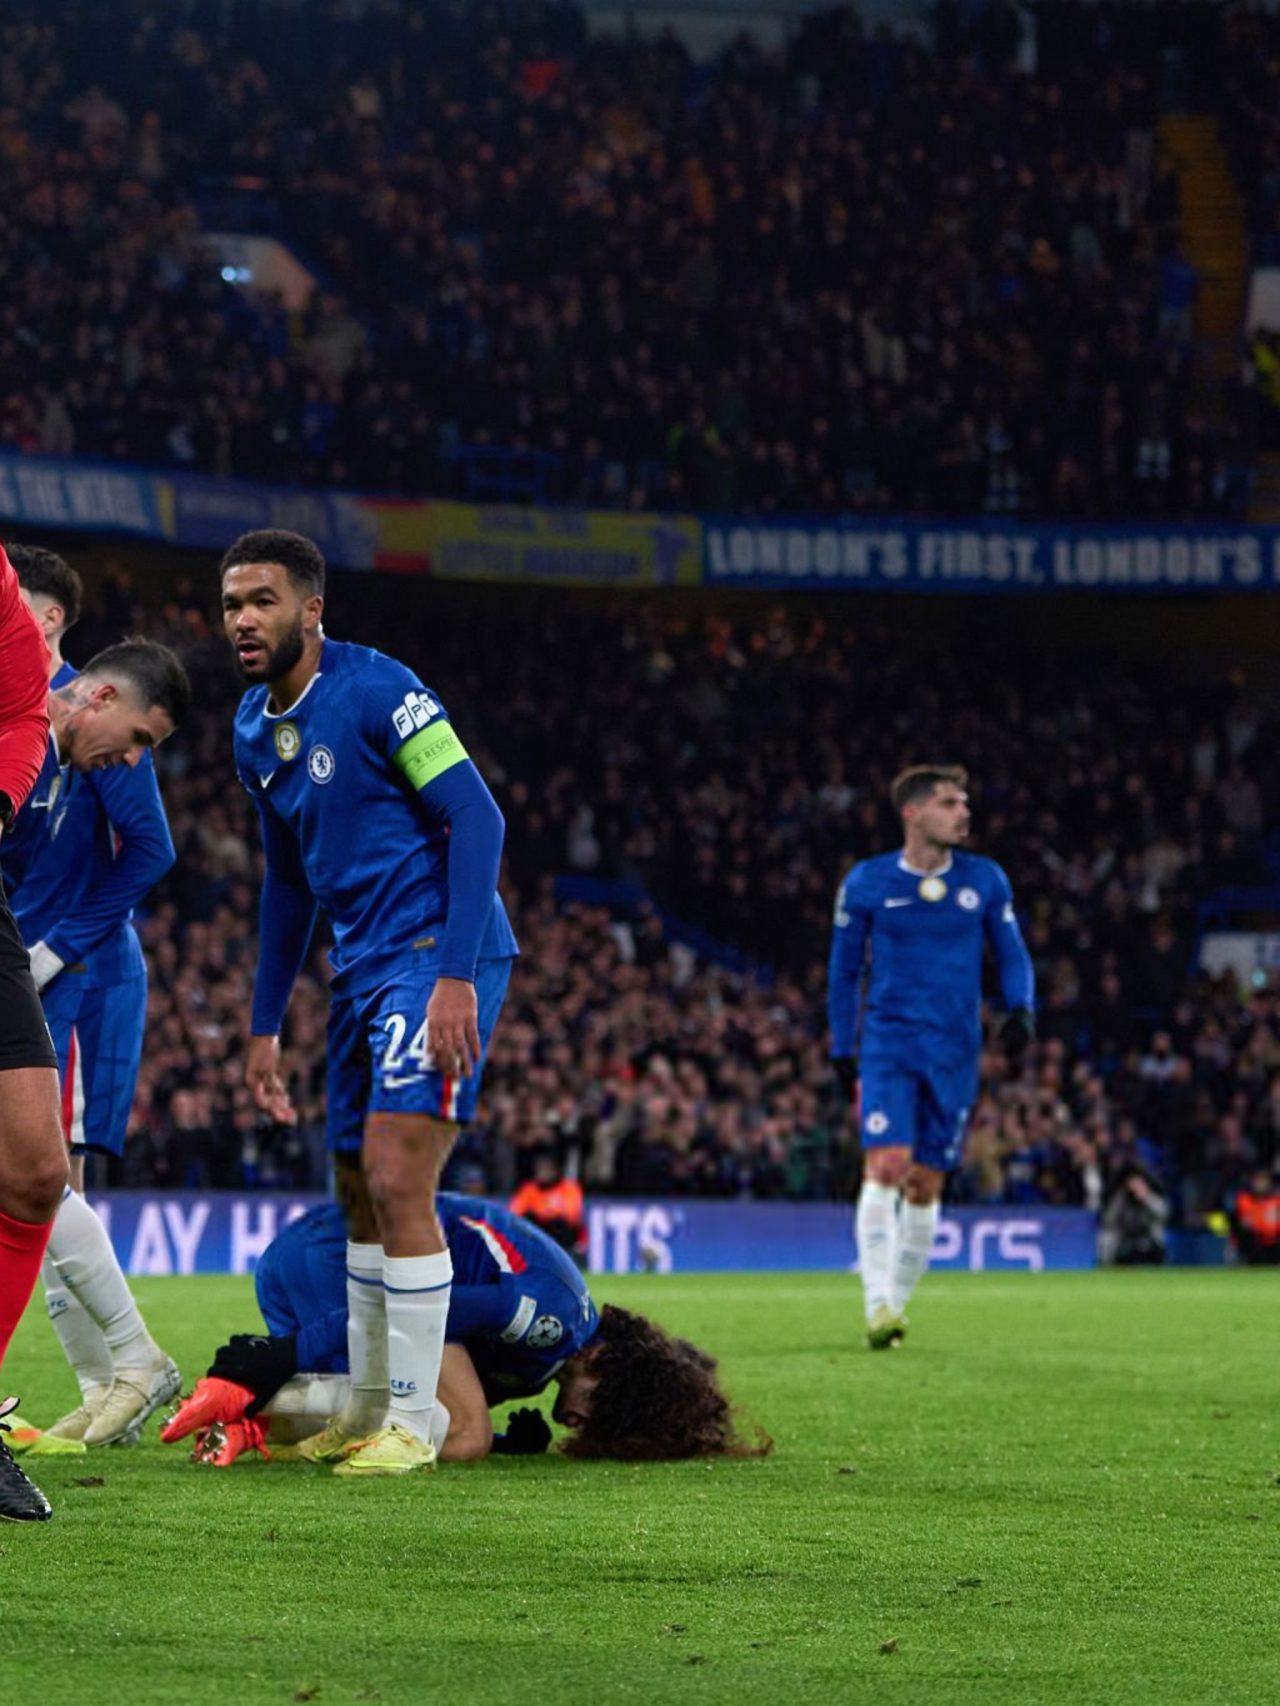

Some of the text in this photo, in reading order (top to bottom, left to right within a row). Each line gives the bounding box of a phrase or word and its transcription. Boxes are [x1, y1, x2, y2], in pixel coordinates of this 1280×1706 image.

[707, 526, 909, 579] LONDON'S
[1052, 534, 1264, 585] LONDON'S
[381, 1013, 436, 1071] 24
